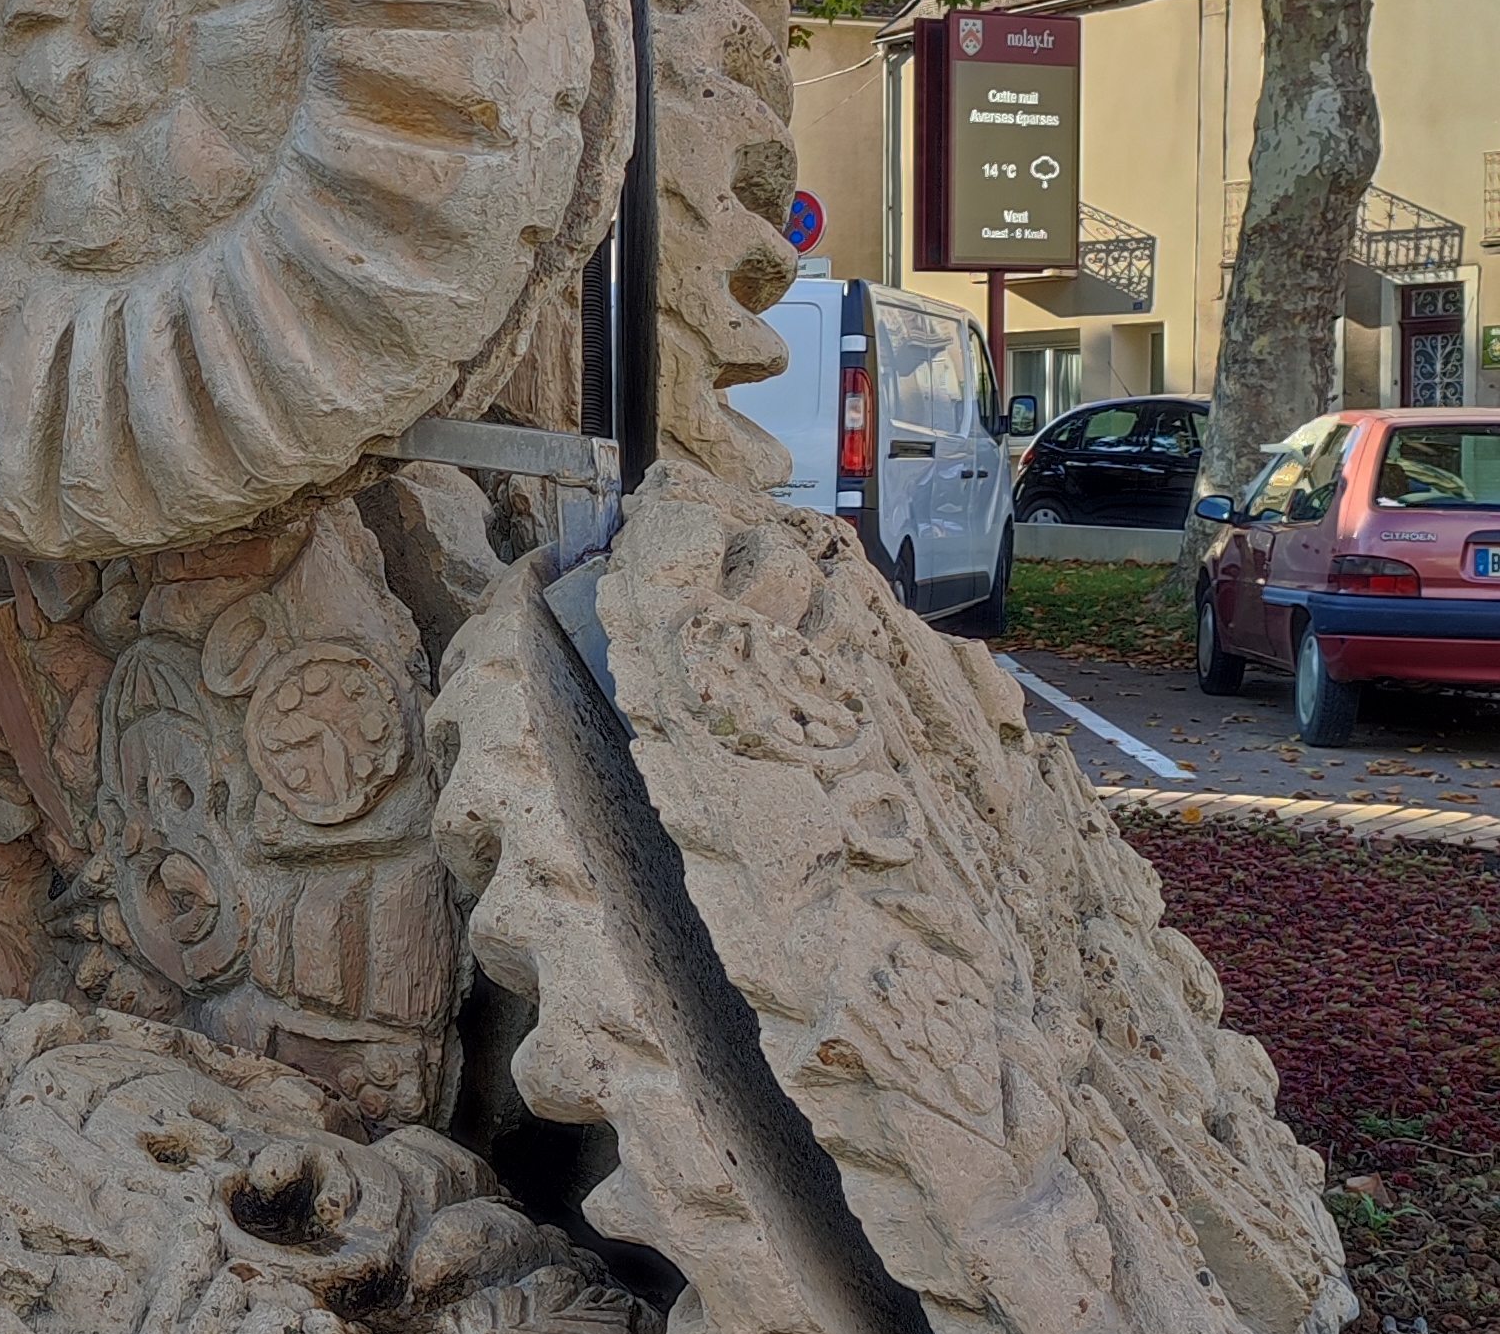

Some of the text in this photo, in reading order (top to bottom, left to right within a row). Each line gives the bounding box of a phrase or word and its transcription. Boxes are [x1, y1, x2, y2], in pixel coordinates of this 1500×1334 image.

[1007, 29, 1055, 54] nolay.fr
[988, 89, 1038, 104] Cette nuit
[970, 109, 1060, 126] Averses éparses
[982, 163, 999, 178] 14
[1003, 210, 1028, 223] Vent
[982, 227, 1009, 238] Ouest
